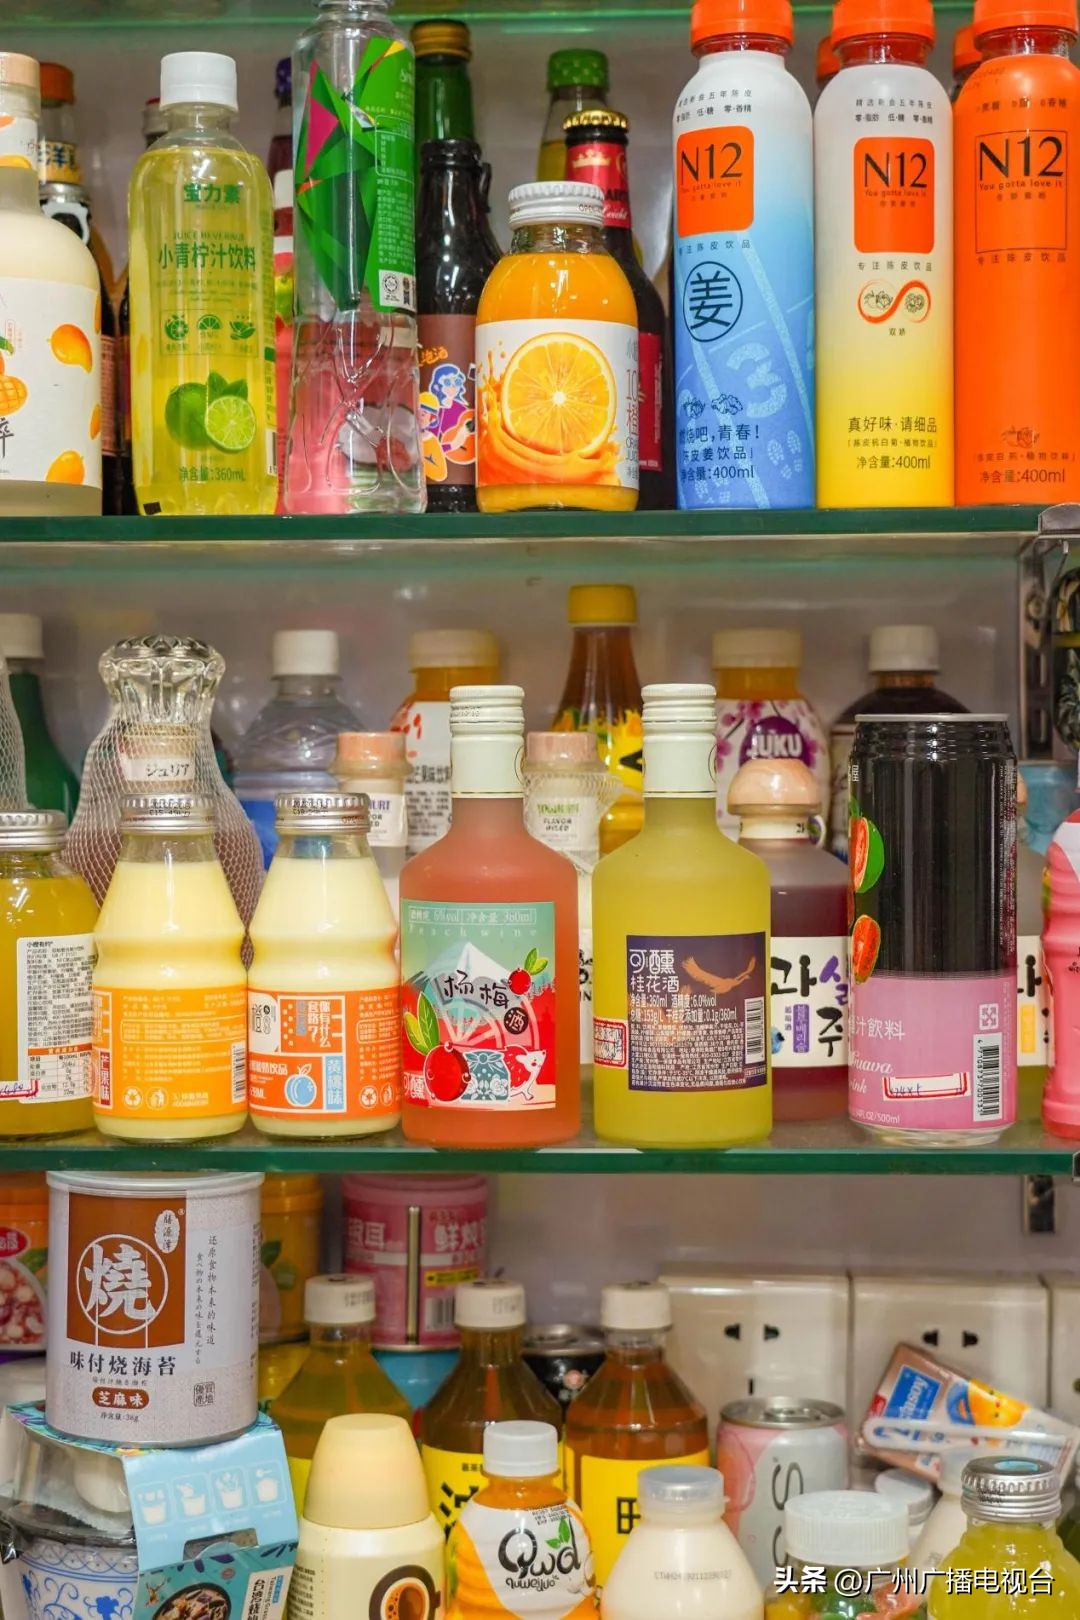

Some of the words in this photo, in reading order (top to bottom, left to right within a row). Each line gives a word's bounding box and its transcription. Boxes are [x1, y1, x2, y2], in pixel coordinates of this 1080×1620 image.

[680, 142, 743, 185] N12
[864, 151, 928, 188] N12
[979, 135, 1064, 181] N12
[979, 182, 995, 191] You
[998, 180, 1026, 191] gotta
[1030, 178, 1051, 188] love
[1055, 179, 1063, 188] it
[158, 242, 257, 272] 小青柠汁饮料
[857, 261, 933, 273] 专注陈皮饮品
[689, 269, 733, 331] 姜
[847, 416, 937, 433] 真好味·请细品
[856, 455, 931, 470] 净含量:400ml
[979, 469, 1066, 484] 净含量:400ml
[444, 969, 510, 1010] 杨梅
[630, 975, 680, 994] 桂花酒
[83, 1243, 157, 1322] 燒
[70, 1351, 177, 1377] 味付烧海苔
[98, 1390, 144, 1407] 芝麻味
